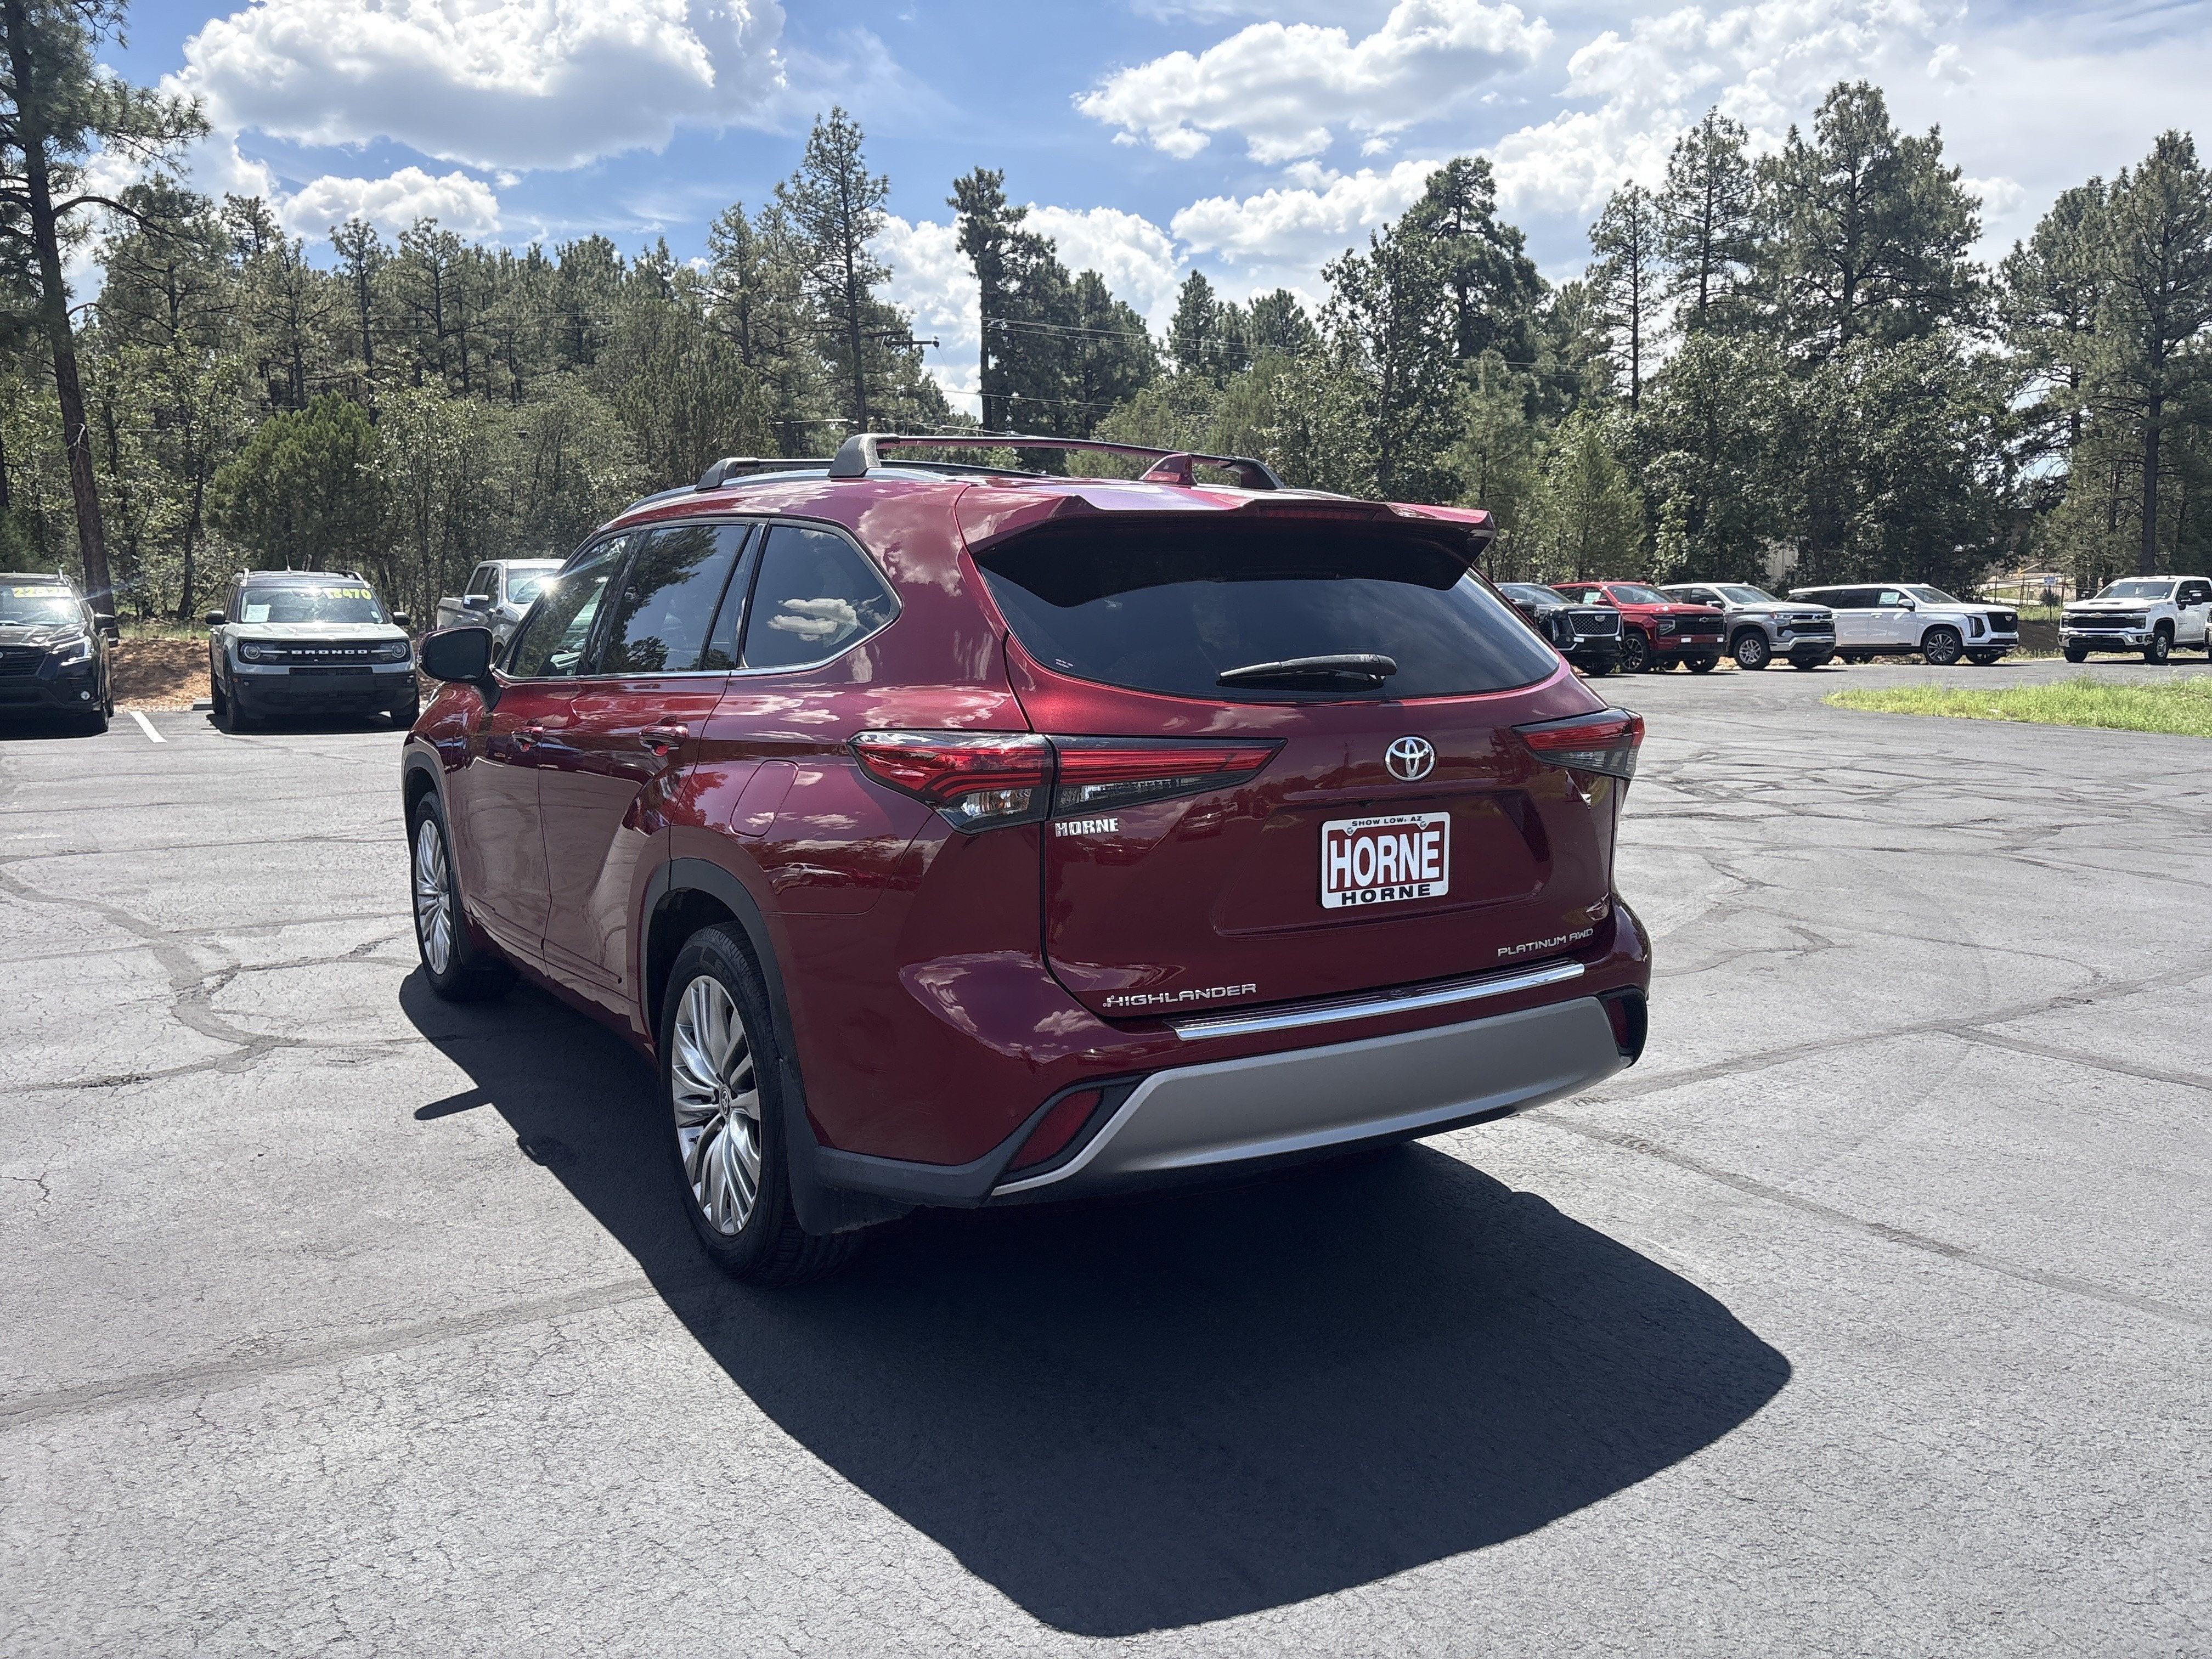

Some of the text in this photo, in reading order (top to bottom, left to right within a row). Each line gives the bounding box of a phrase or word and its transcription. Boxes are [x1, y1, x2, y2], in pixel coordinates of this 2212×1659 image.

[1054, 817, 1119, 837] HORNE
[1329, 830, 1440, 890] HORNE
[1341, 883, 1431, 905] HORNE
[1497, 928, 1594, 957] PLATINUM AWD
[1106, 983, 1256, 1008] HIGHLANDER
